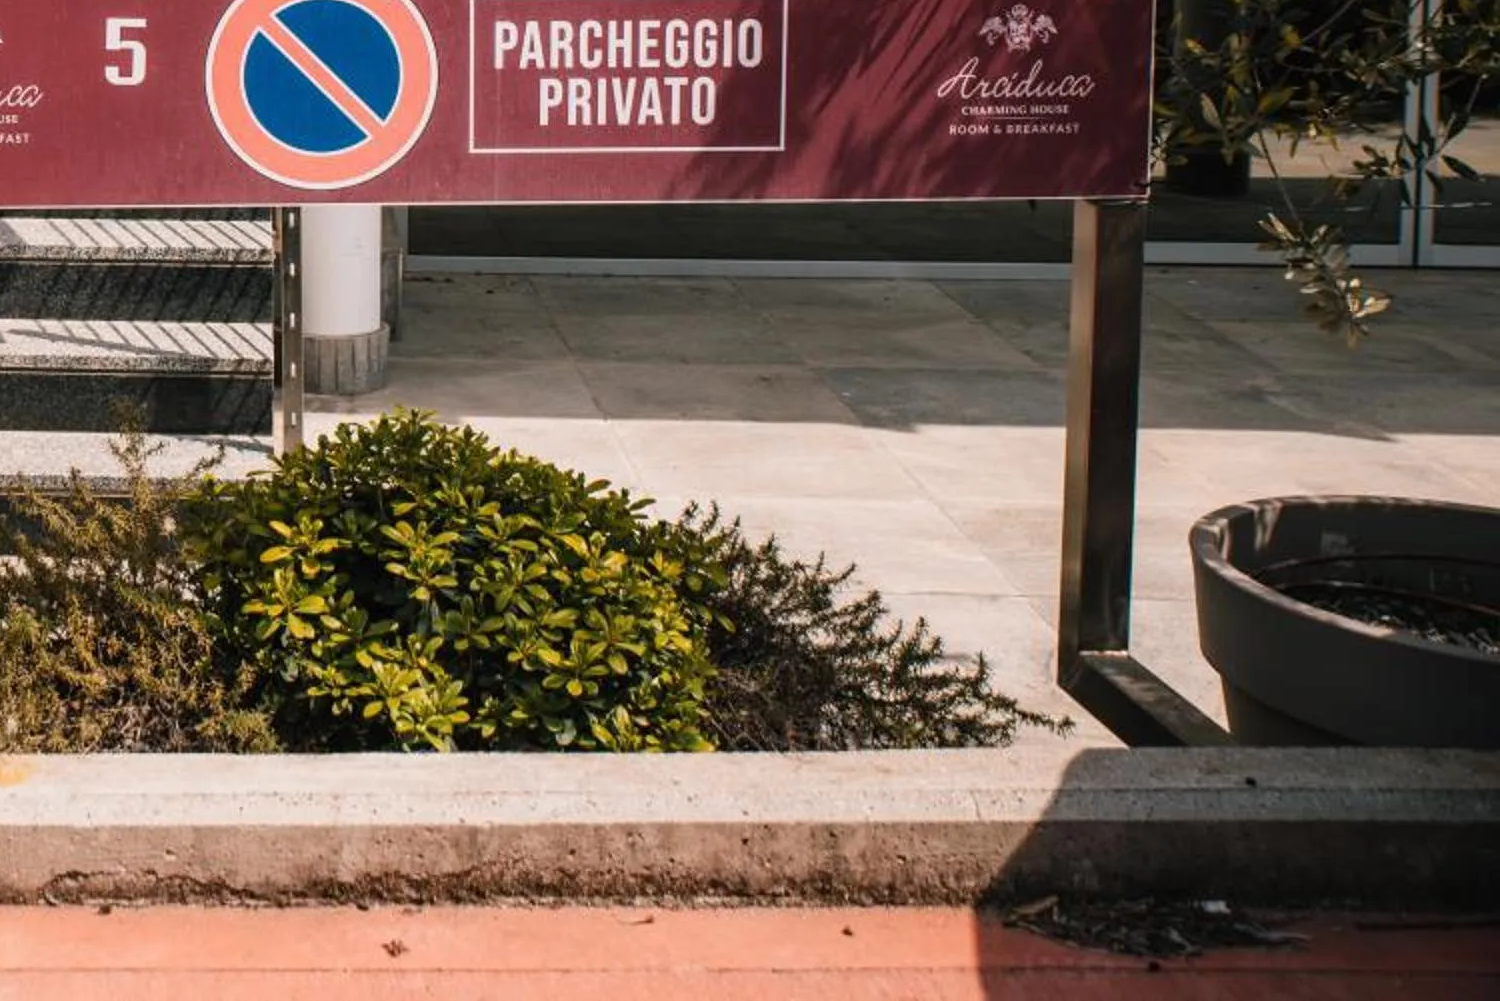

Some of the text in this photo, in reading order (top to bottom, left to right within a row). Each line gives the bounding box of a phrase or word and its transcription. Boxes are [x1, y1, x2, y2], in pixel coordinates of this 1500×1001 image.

[104, 17, 148, 86] 5
[493, 19, 764, 70] PARCHEGGIO
[937, 56, 1096, 99] Arciduca
[539, 76, 717, 127] PRIVATO
[961, 104, 1069, 116] CHARMING HOUSE
[949, 124, 989, 135] ROOM
[1006, 123, 1080, 134] BREAKFAST
